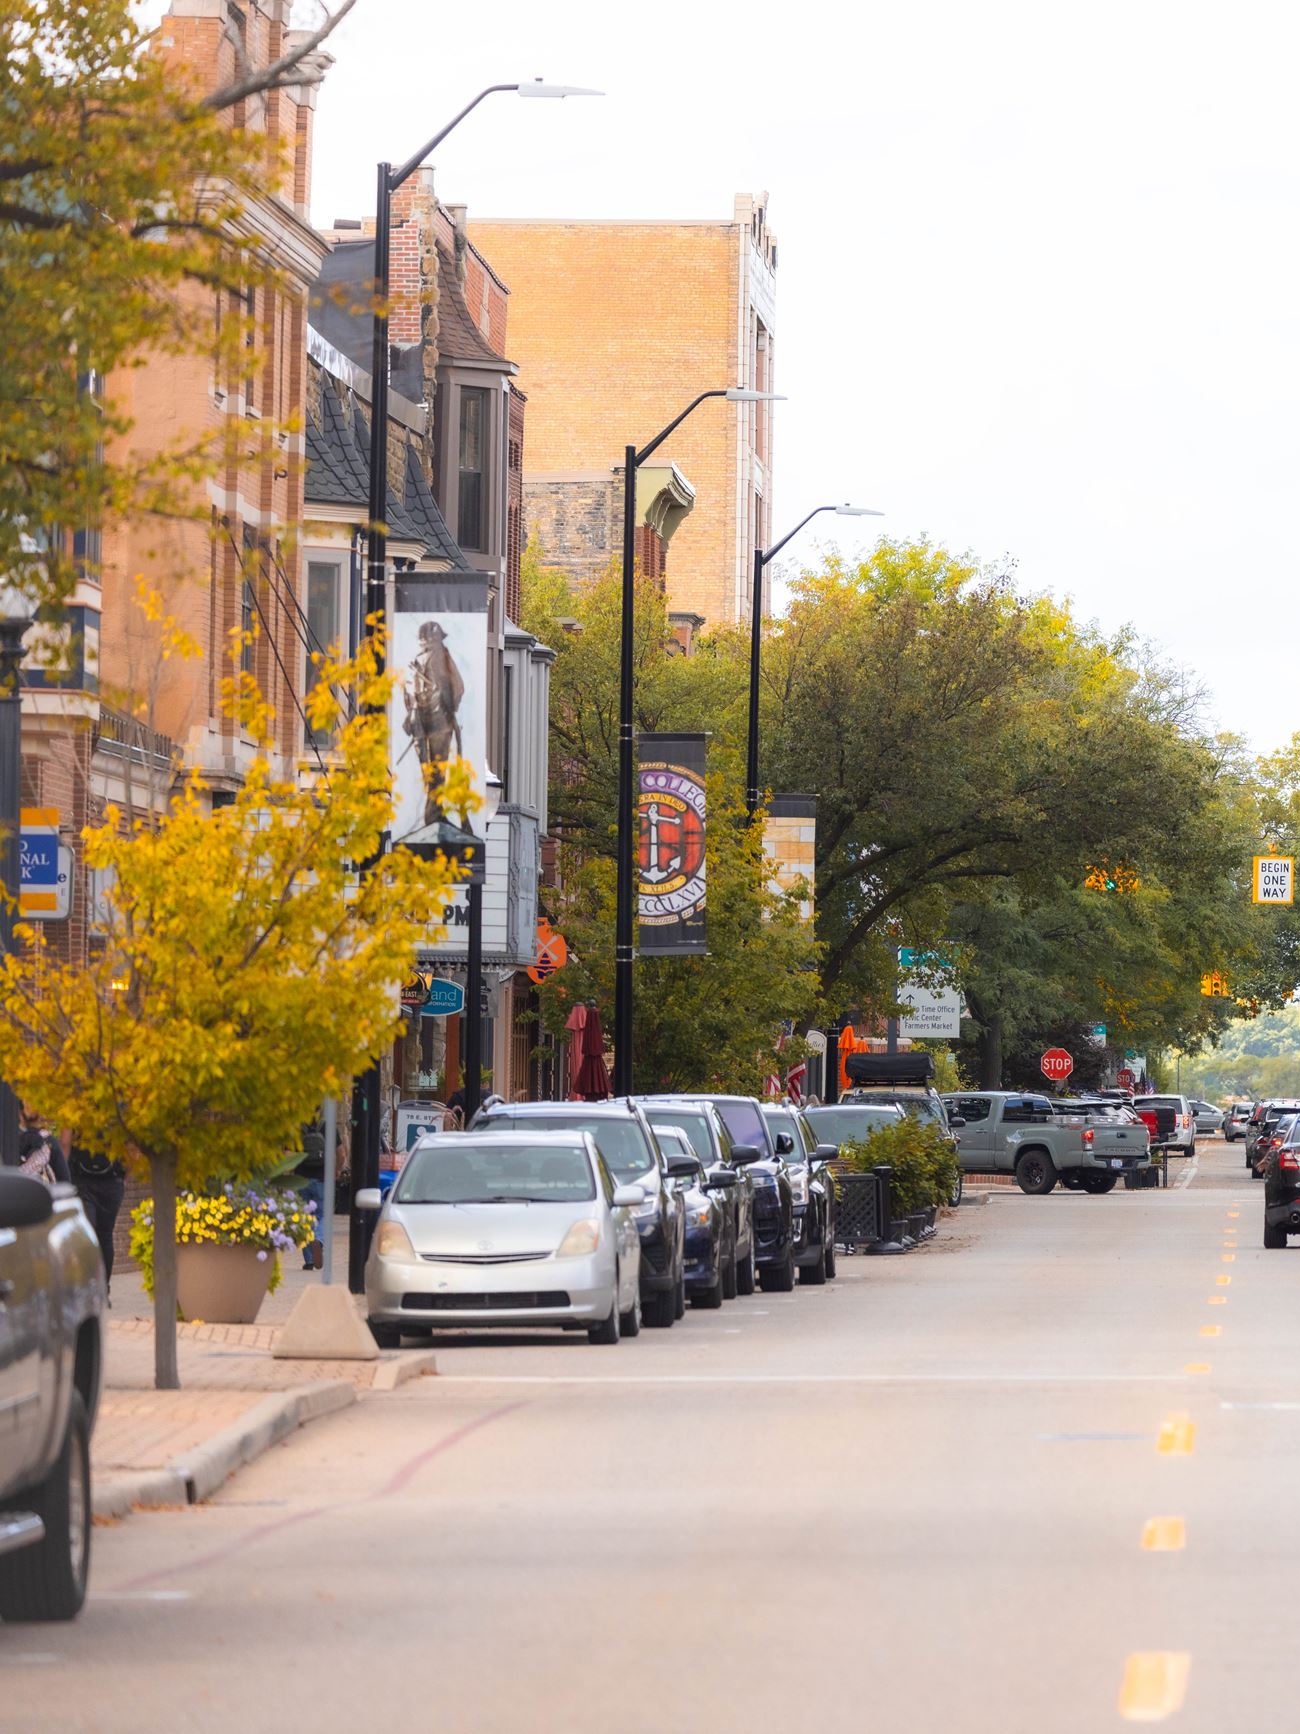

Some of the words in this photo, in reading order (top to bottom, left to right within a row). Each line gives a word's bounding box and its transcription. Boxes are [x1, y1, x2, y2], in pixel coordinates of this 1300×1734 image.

[1261, 863, 1290, 873] BEGIN
[1263, 876, 1286, 886] ONE
[1262, 888, 1286, 898] WAY
[904, 1022, 930, 1030] Farmers
[931, 1022, 953, 1030] Market
[1043, 1059, 1071, 1070] STOP
